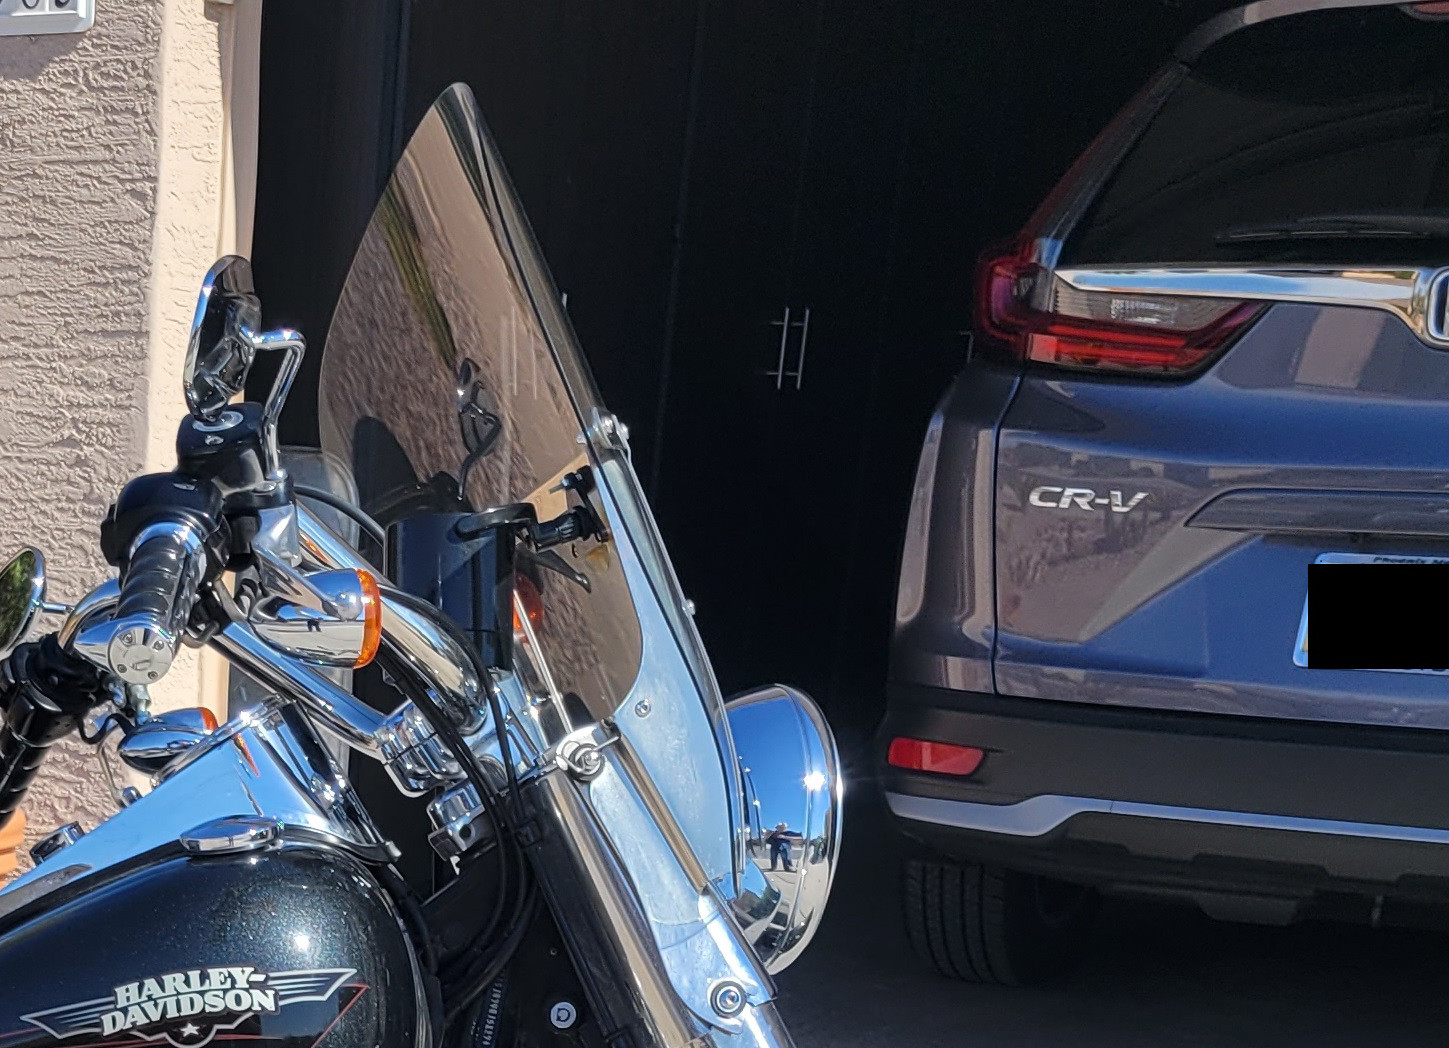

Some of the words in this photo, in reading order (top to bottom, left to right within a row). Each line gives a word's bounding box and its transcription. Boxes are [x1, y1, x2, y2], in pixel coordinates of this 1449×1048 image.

[1029, 486, 1149, 513] CR-V
[114, 967, 266, 1009] HARLEY-
[101, 989, 276, 1037] DAVIDSON
